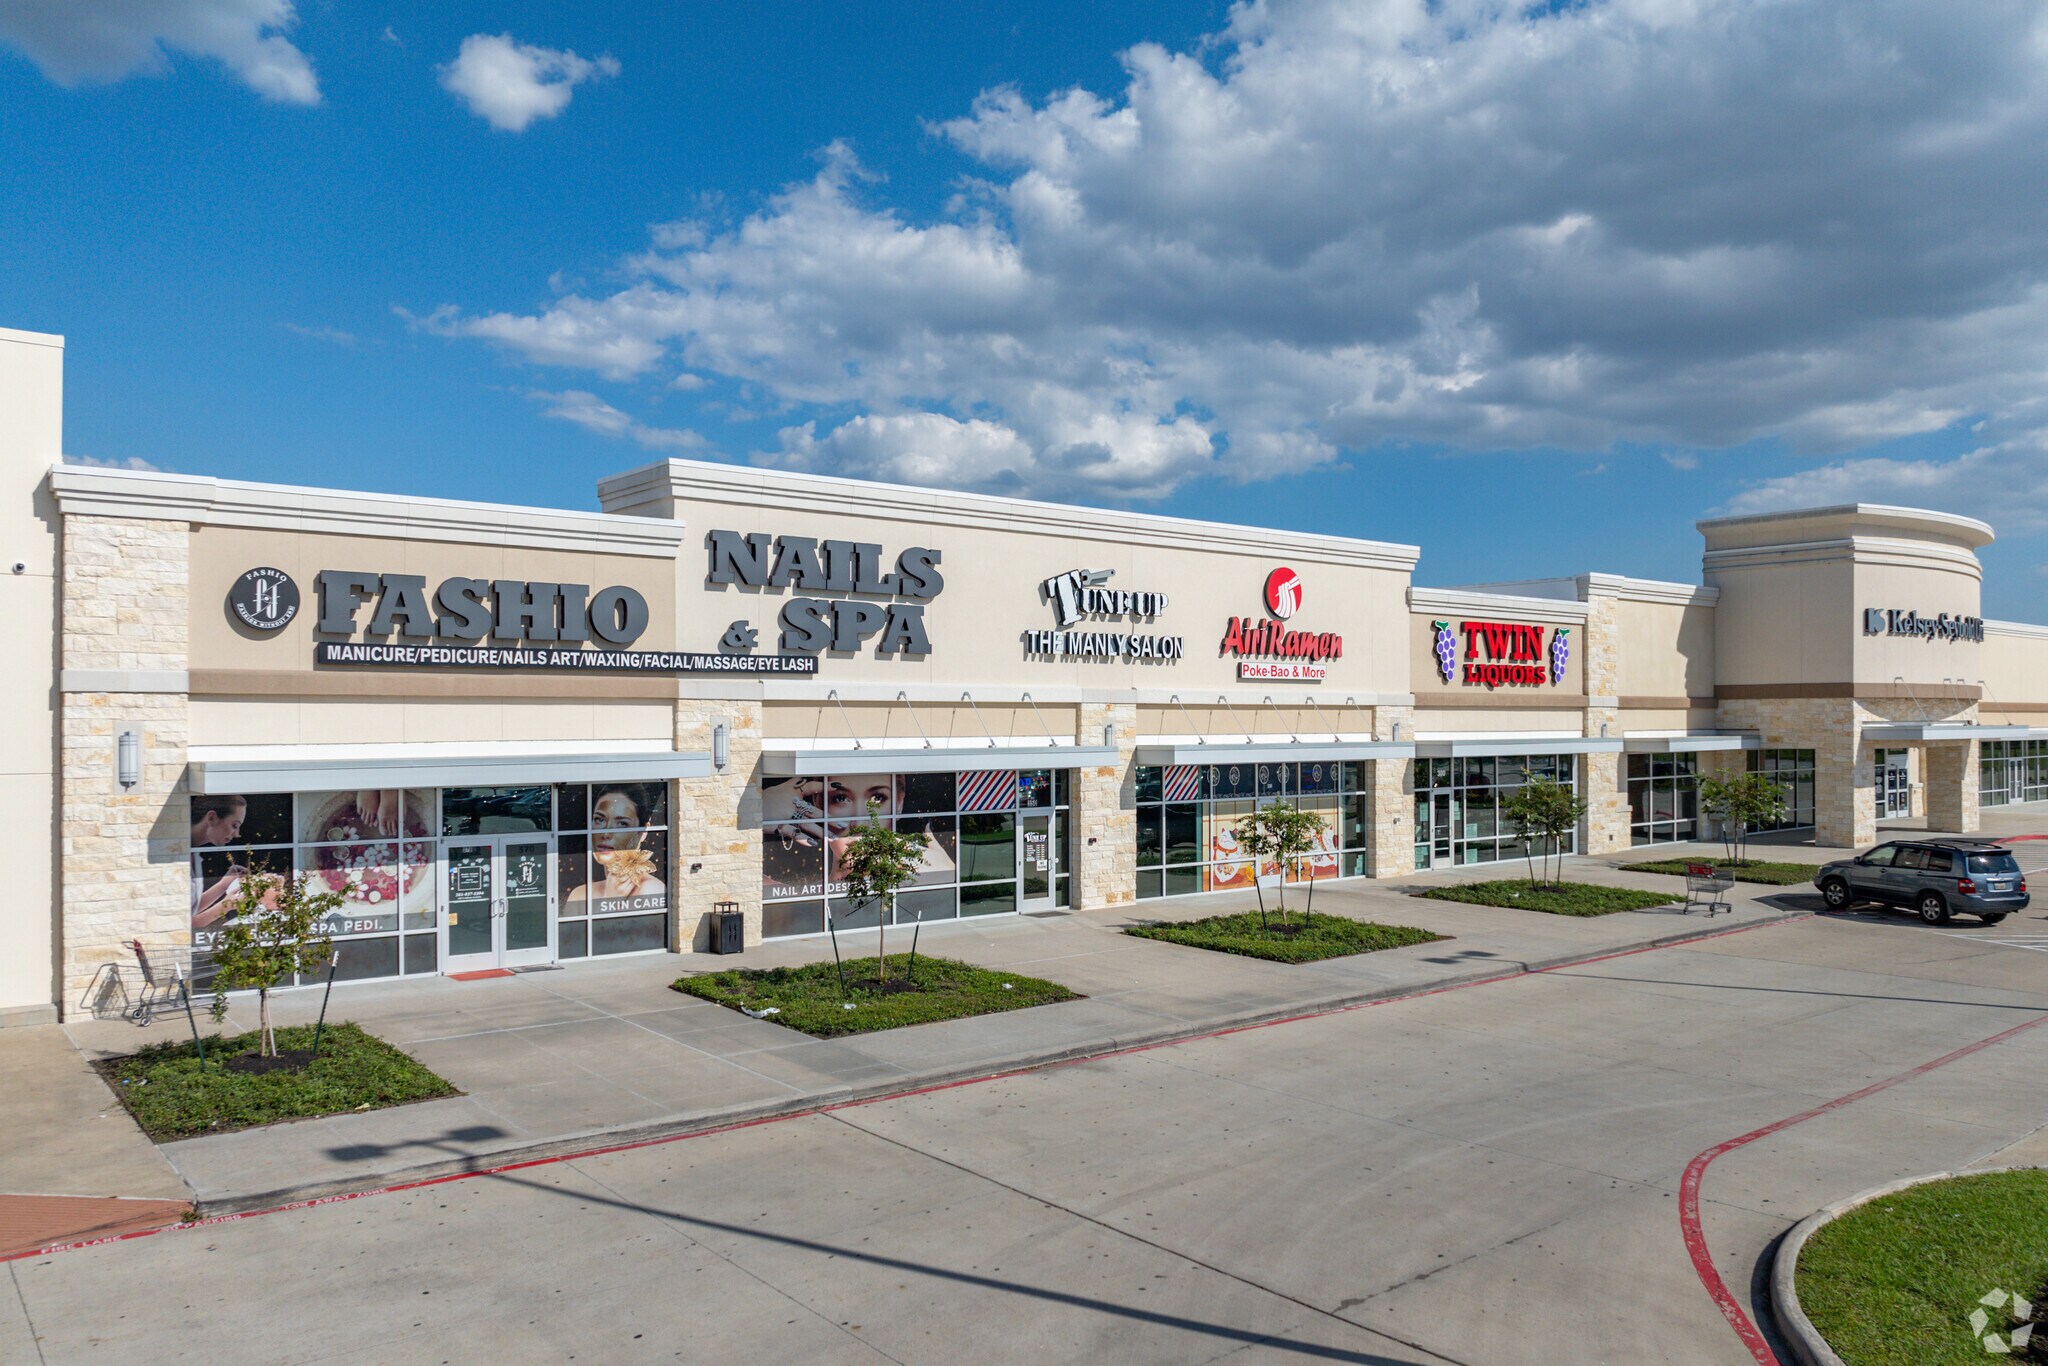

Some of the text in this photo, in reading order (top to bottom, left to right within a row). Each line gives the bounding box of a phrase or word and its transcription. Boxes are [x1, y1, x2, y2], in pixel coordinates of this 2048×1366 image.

[246, 570, 287, 581] FASHIO
[708, 529, 944, 598] NAILS
[319, 570, 649, 643] FASHIO
[723, 597, 932, 655] & SPA
[1027, 629, 1184, 659] THE MANLY SALON
[1461, 621, 1545, 661] TWIN
[327, 644, 814, 671] MANICURE/PEDICURE/NAILS ART/WAXING/FACIAL/MASSAGE/EYE LASH
[1292, 665, 1299, 678] &
[1302, 666, 1326, 679] More
[1464, 663, 1547, 687] LIQUORS
[772, 886, 798, 897] NAIL
[801, 884, 822, 895] ART
[600, 897, 666, 911] SKIN CARE
[309, 920, 384, 934] SPA PEDI.
